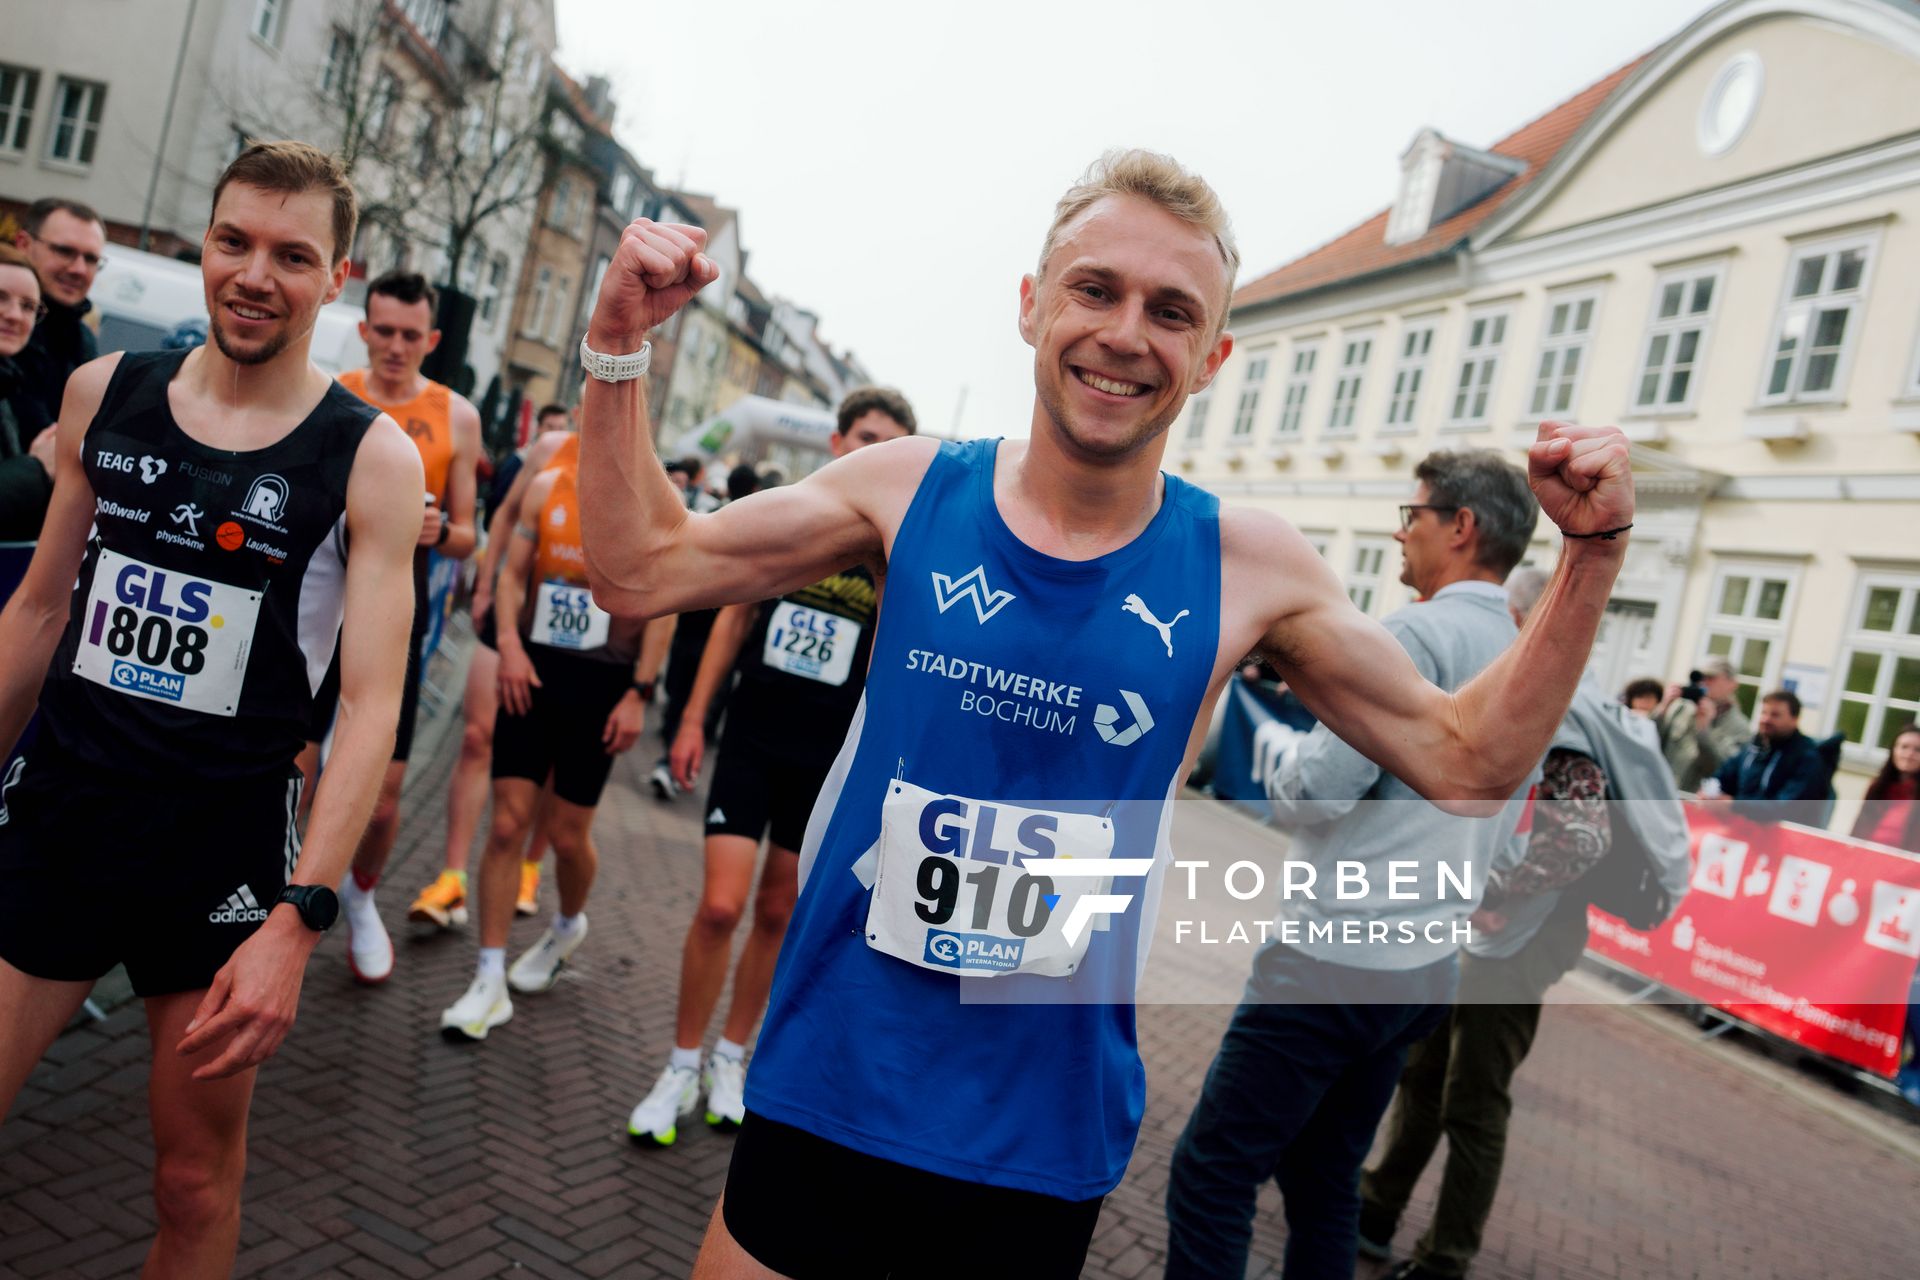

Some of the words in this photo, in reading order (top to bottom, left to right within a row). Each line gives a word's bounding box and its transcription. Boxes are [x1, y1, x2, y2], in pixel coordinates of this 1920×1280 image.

[97, 451, 135, 473] TEAG
[178, 461, 233, 487] FUSION
[156, 530, 205, 551] physio4me
[246, 537, 288, 560] Laufladen
[548, 608, 590, 634] 200
[106, 606, 209, 676] 808
[784, 630, 834, 663] 226
[139, 671, 182, 692] PLAN
[906, 649, 1083, 708] STADTWERKE
[138, 684, 179, 698] INTERNATIONAL
[960, 690, 1077, 736] BOCHUM
[914, 856, 1055, 938] 910
[209, 908, 268, 923] adidas
[966, 940, 1021, 961] PLAN
[966, 957, 1015, 969] INTERNATIONAL
